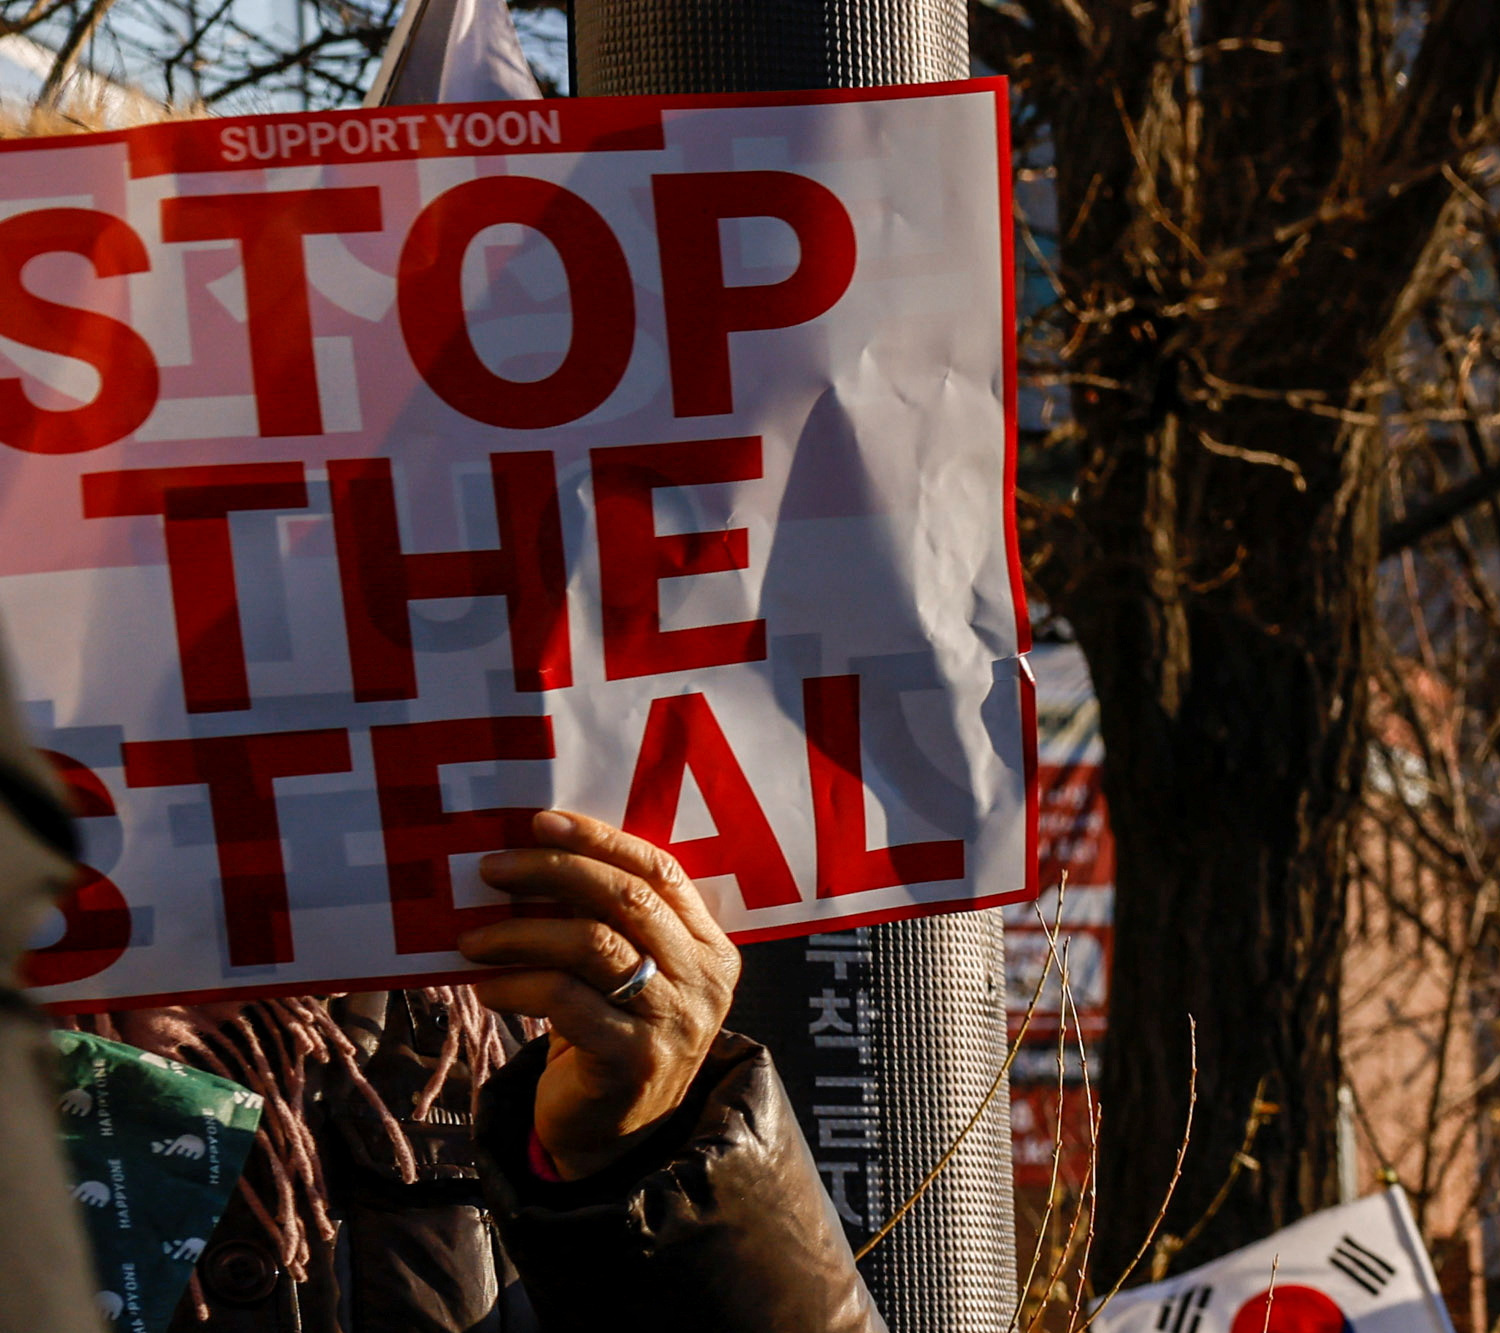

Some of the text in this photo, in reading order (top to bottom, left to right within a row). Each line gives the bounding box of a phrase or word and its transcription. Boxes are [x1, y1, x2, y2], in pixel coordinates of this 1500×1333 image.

[218, 108, 563, 163] SUPPORT YOON
[0, 169, 857, 455] STOP
[81, 436, 767, 714] THE
[108, 1157, 132, 1230] HAPPYONE
